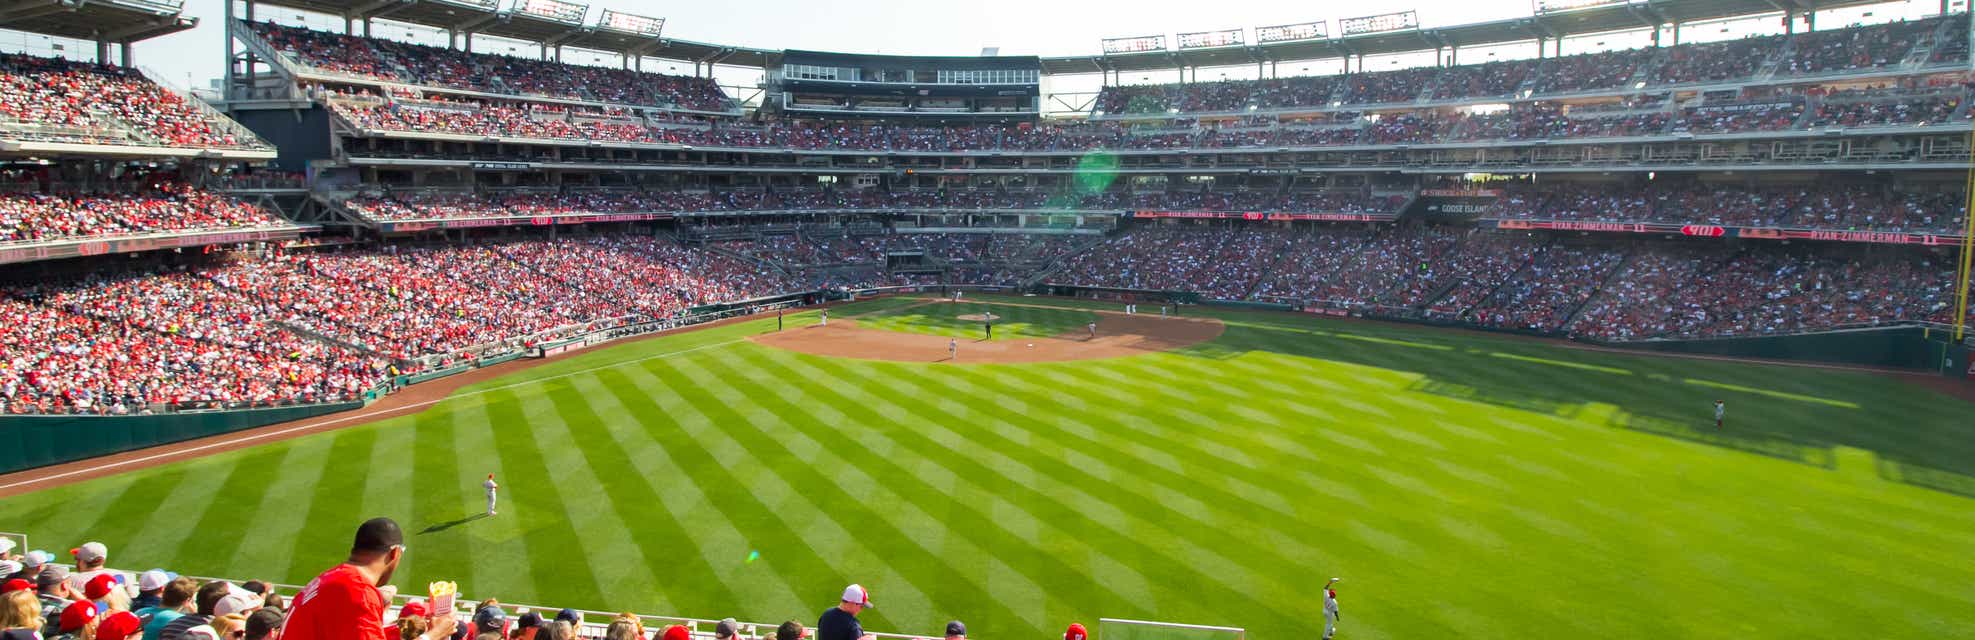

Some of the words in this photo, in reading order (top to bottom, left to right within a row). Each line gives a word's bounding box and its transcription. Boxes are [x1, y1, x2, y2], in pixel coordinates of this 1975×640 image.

[1442, 205, 1462, 213] GOOSE
[1552, 221, 1572, 230] RYAN
[1574, 222, 1624, 232] ZIMMERMAN
[1634, 224, 1646, 232] 11
[1811, 231, 1838, 241] RYAN
[1840, 232, 1909, 244] ZIMMERMAN
[1923, 235, 1937, 245] 11
